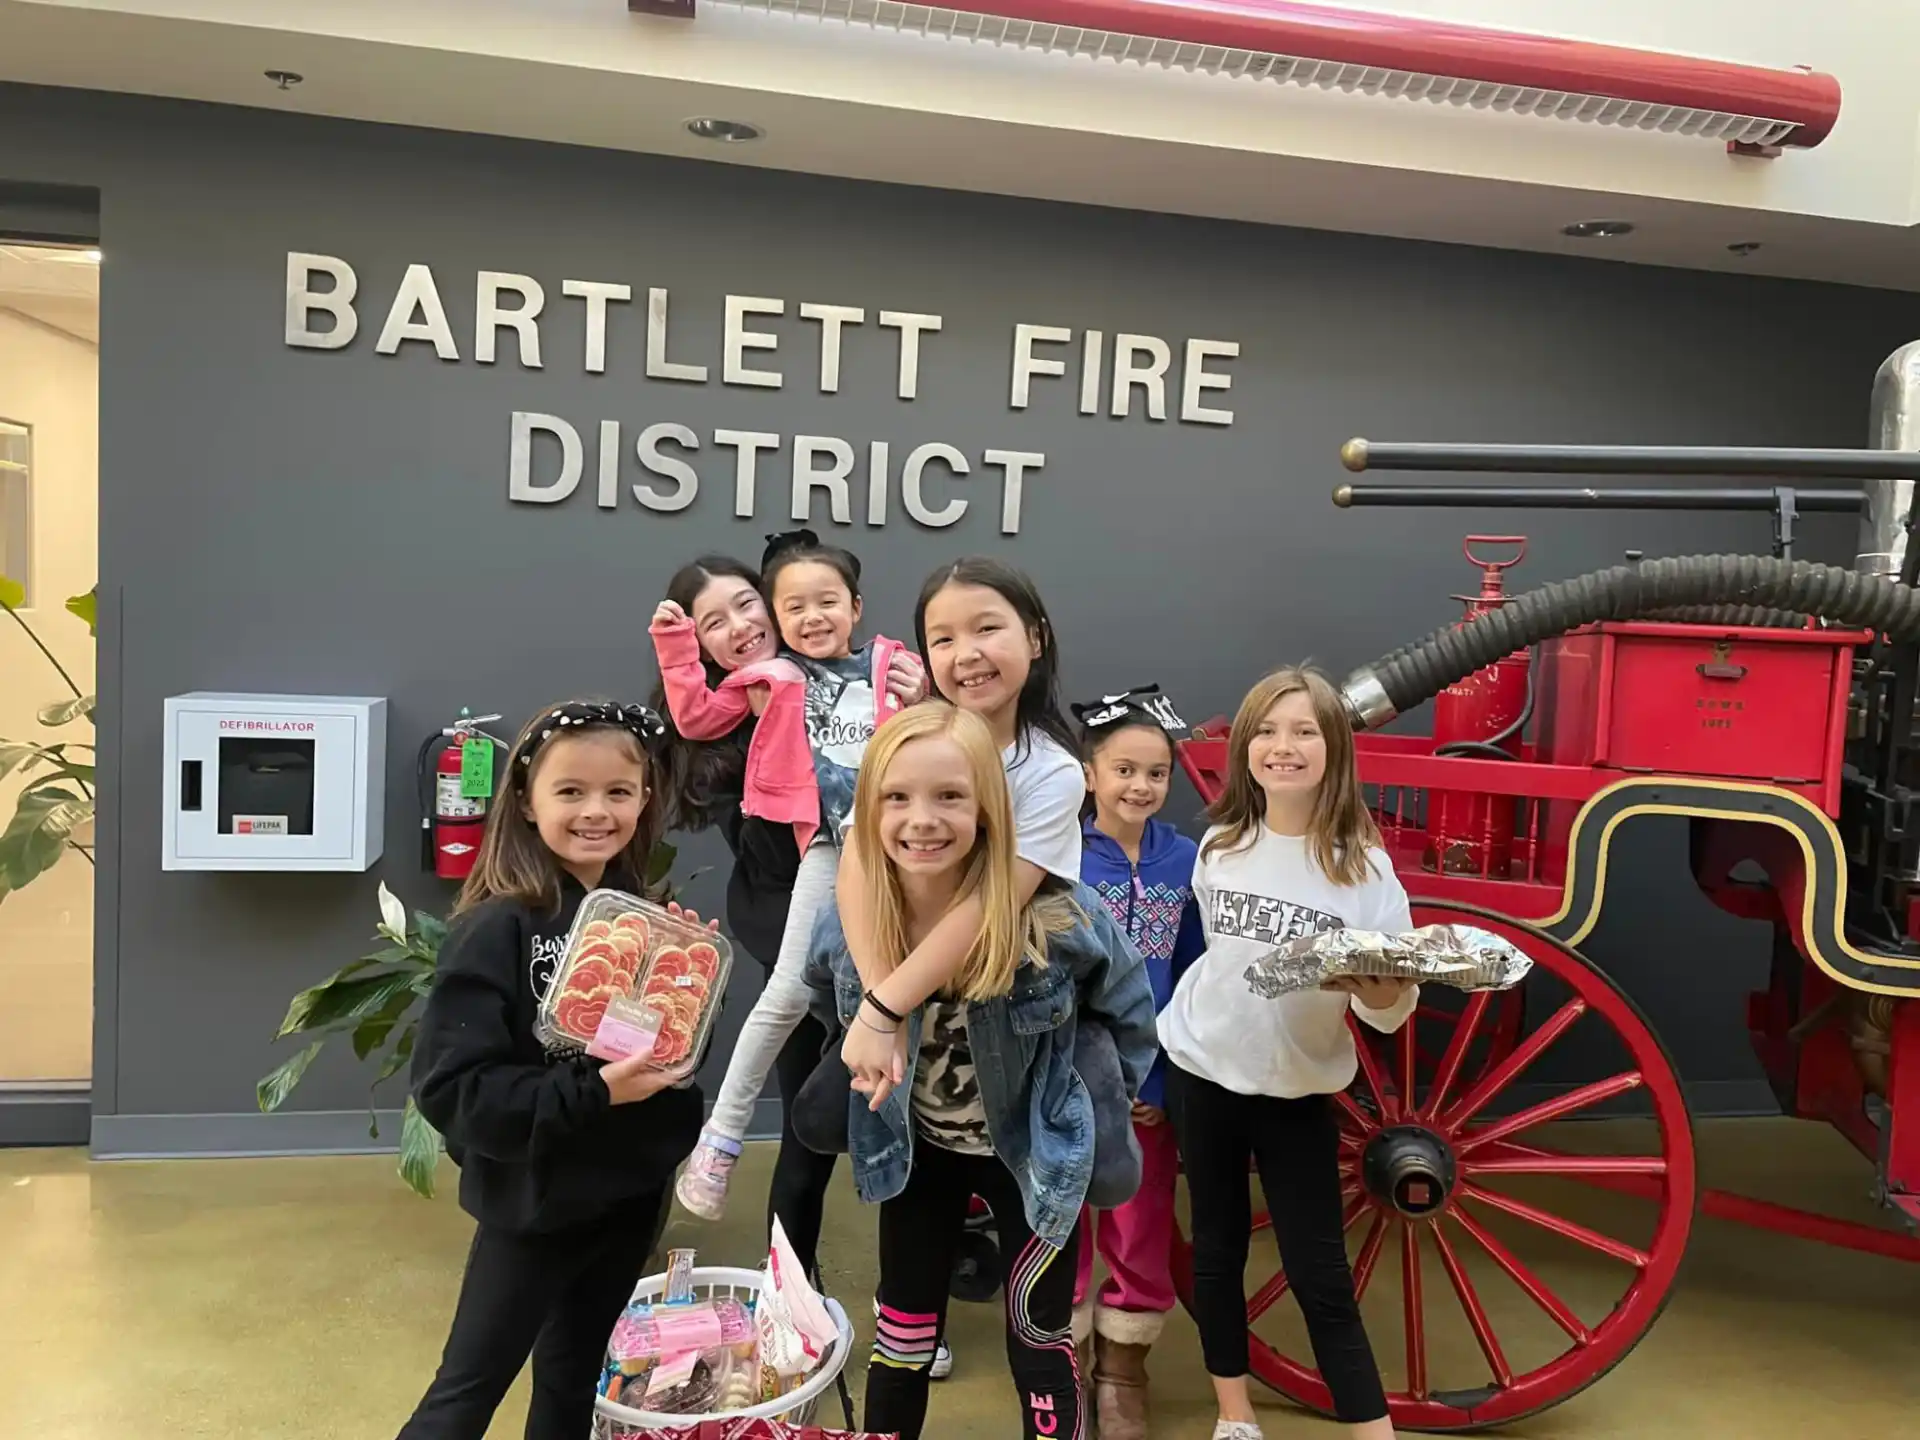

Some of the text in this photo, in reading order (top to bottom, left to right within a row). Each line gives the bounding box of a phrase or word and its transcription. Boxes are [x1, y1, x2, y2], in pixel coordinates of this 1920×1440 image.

[284, 250, 1241, 426] BARTLETT FIRE
[508, 409, 1046, 535] DISTRICT
[219, 719, 315, 733] DEFIBRILLATOR
